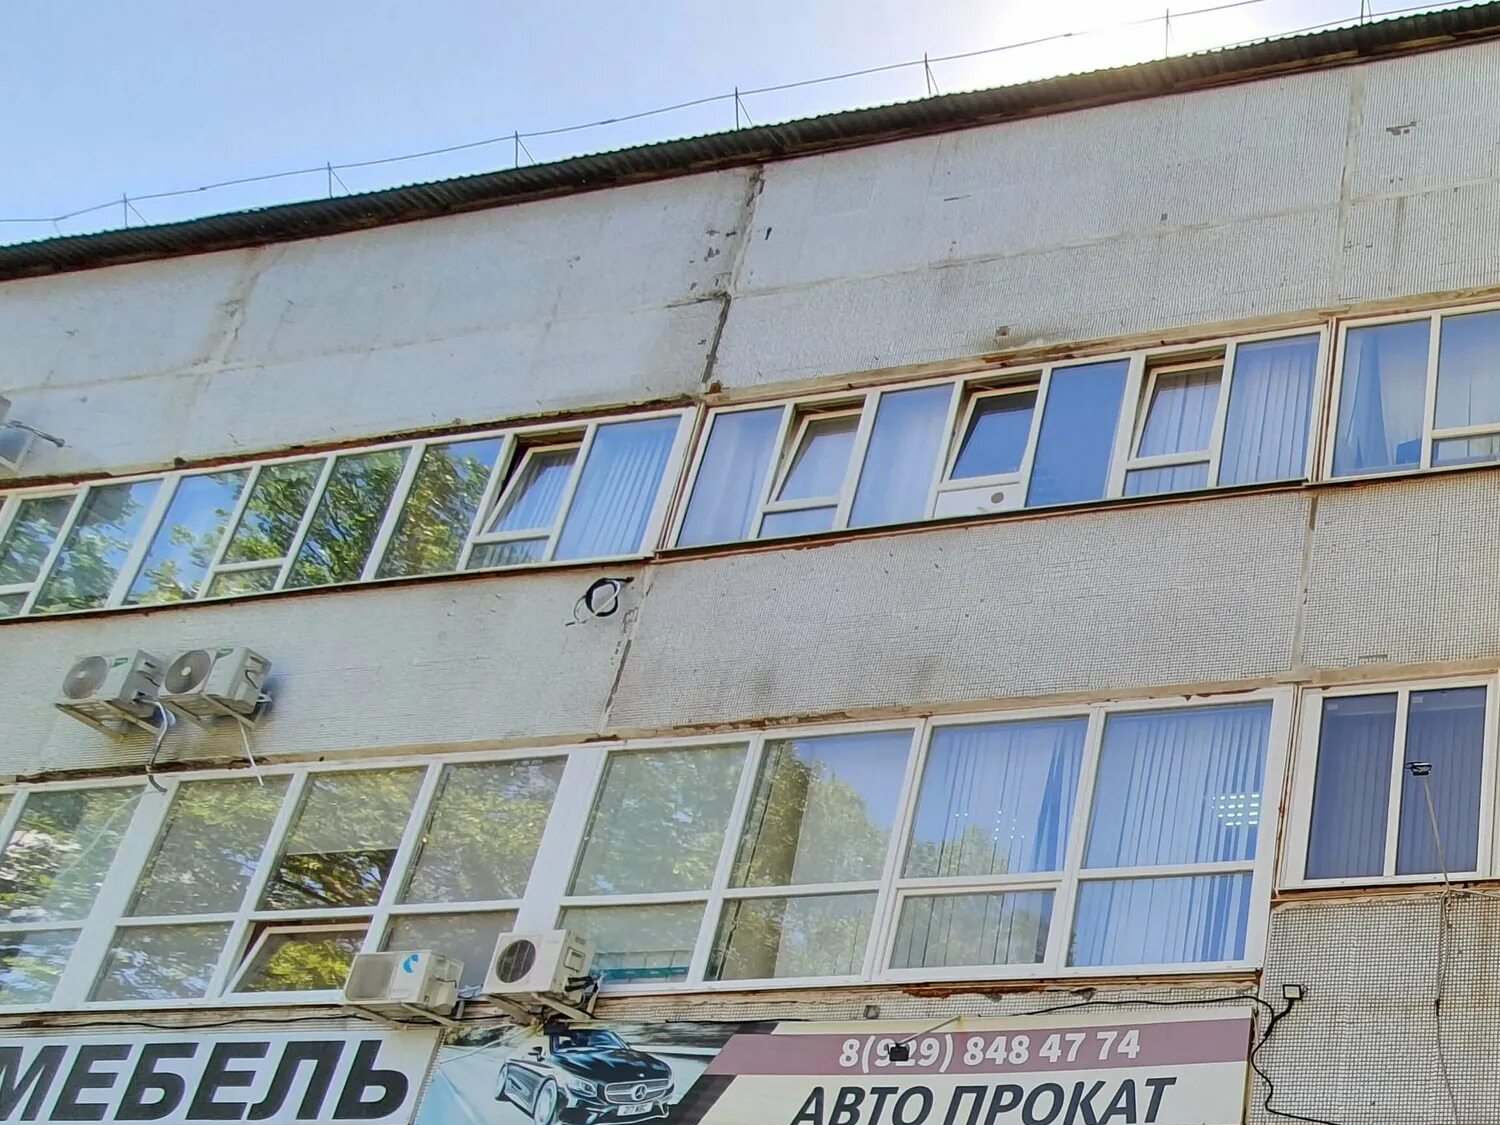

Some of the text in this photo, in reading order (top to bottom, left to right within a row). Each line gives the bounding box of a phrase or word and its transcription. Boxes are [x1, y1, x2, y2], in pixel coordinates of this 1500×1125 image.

[963, 1035, 1030, 1067] 848
[1038, 1033, 1091, 1064] 47
[1096, 1030, 1142, 1060] 74
[0, 1039, 410, 1122] МЕБЕЛЬ
